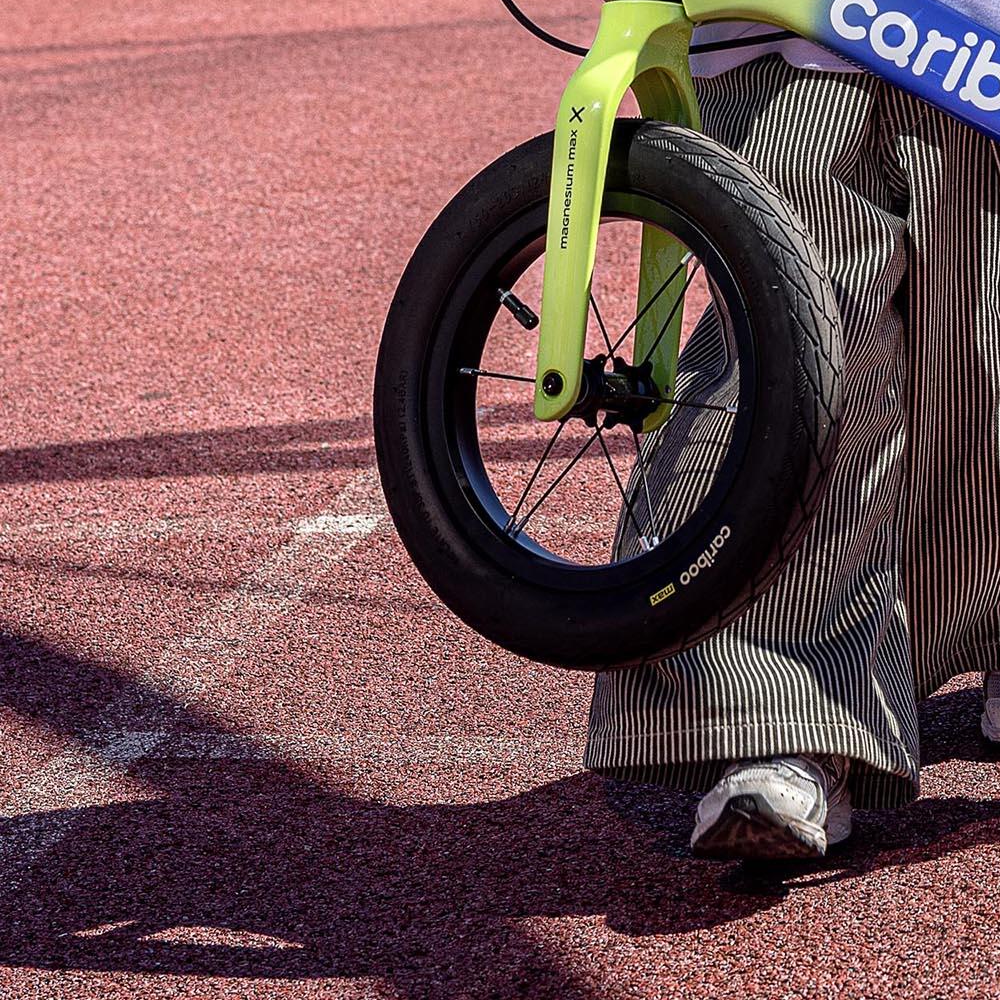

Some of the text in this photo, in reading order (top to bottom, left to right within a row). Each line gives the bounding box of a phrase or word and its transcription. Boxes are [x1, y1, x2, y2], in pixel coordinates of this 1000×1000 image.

[568, 129, 578, 160] max
[650, 525, 731, 605] cariboo max
